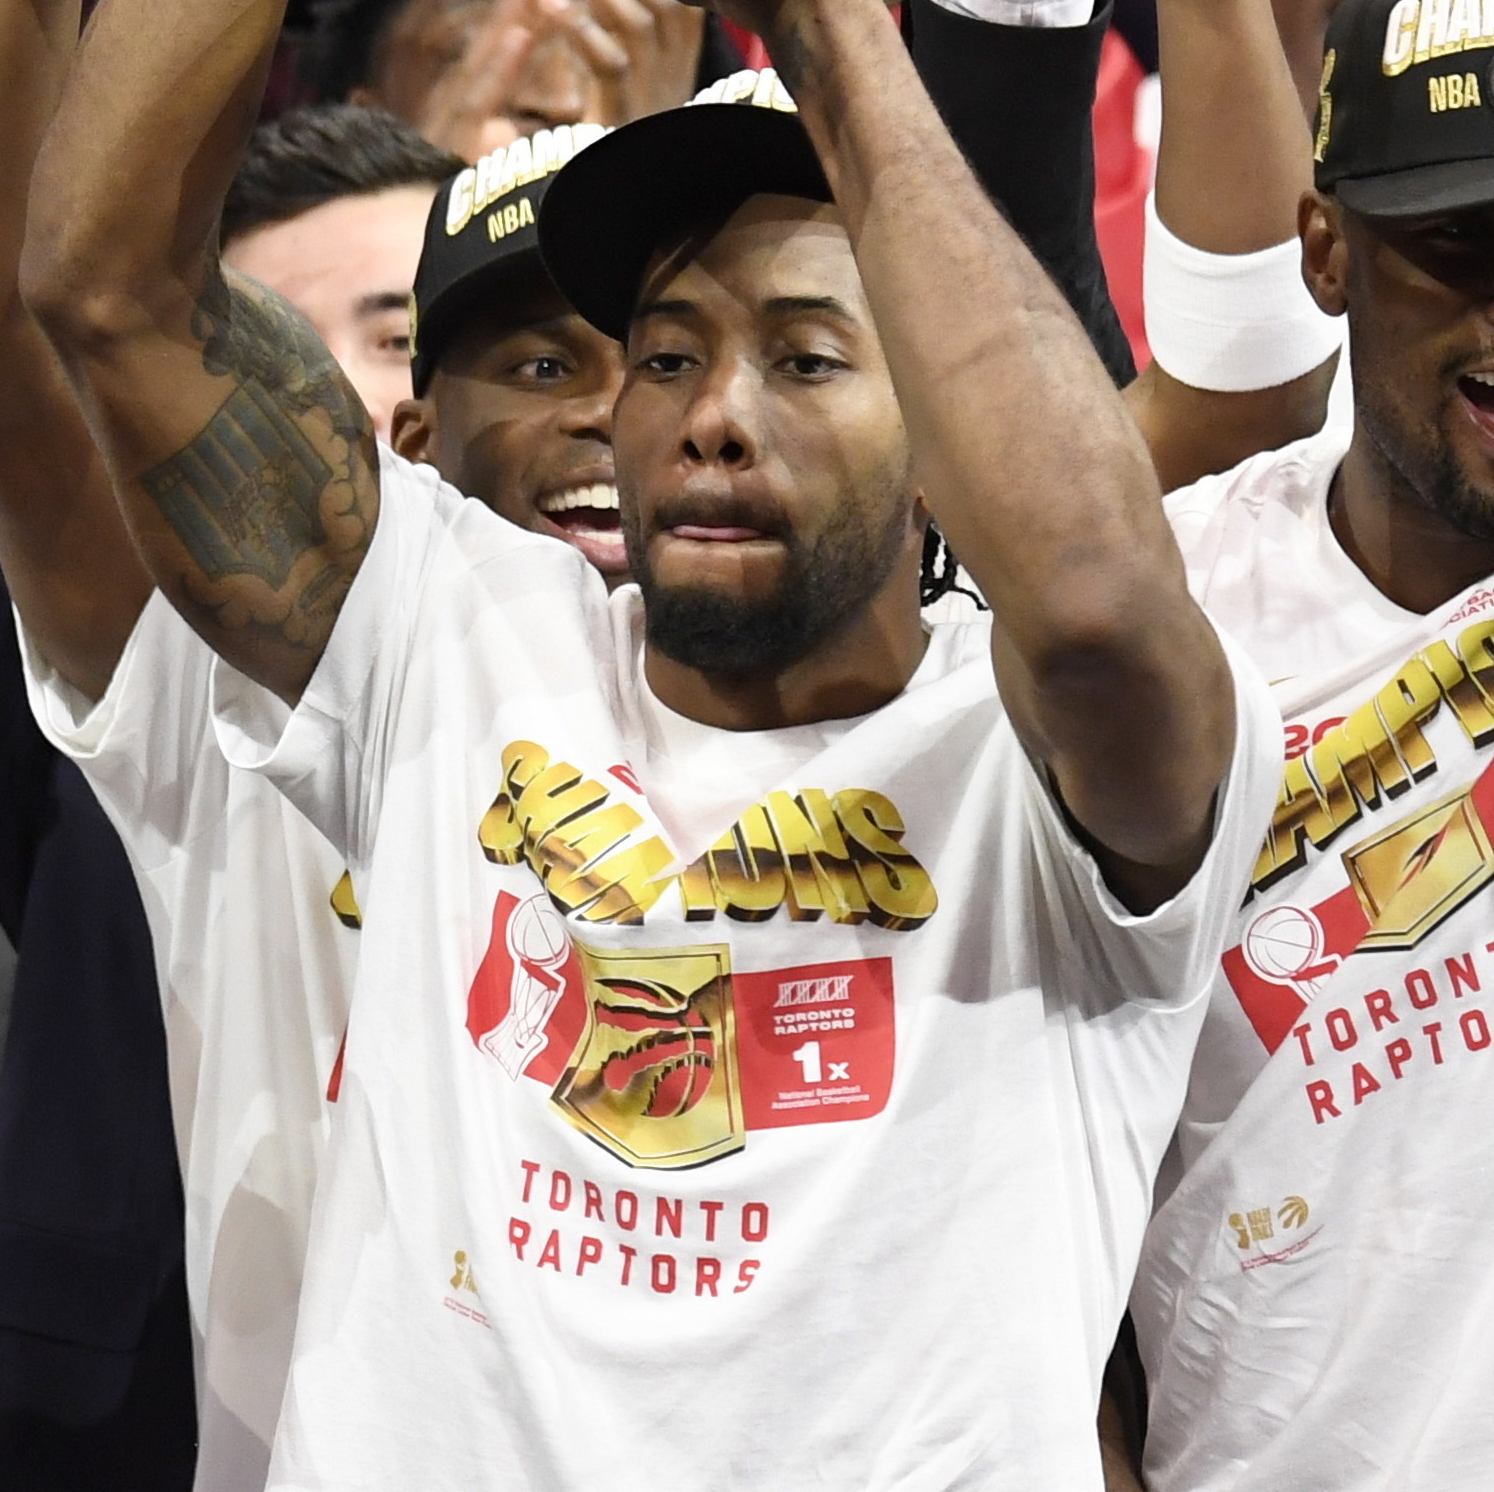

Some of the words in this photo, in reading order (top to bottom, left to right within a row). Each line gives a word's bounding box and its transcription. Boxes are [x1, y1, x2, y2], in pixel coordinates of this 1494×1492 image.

[1427, 72, 1482, 113] NBA
[486, 197, 536, 244] NBA
[772, 1007, 855, 1025] TORONTO
[773, 1018, 855, 1036] RAPTORS
[521, 1159, 770, 1243] TORONTO
[508, 1216, 762, 1298] RAPTORS
